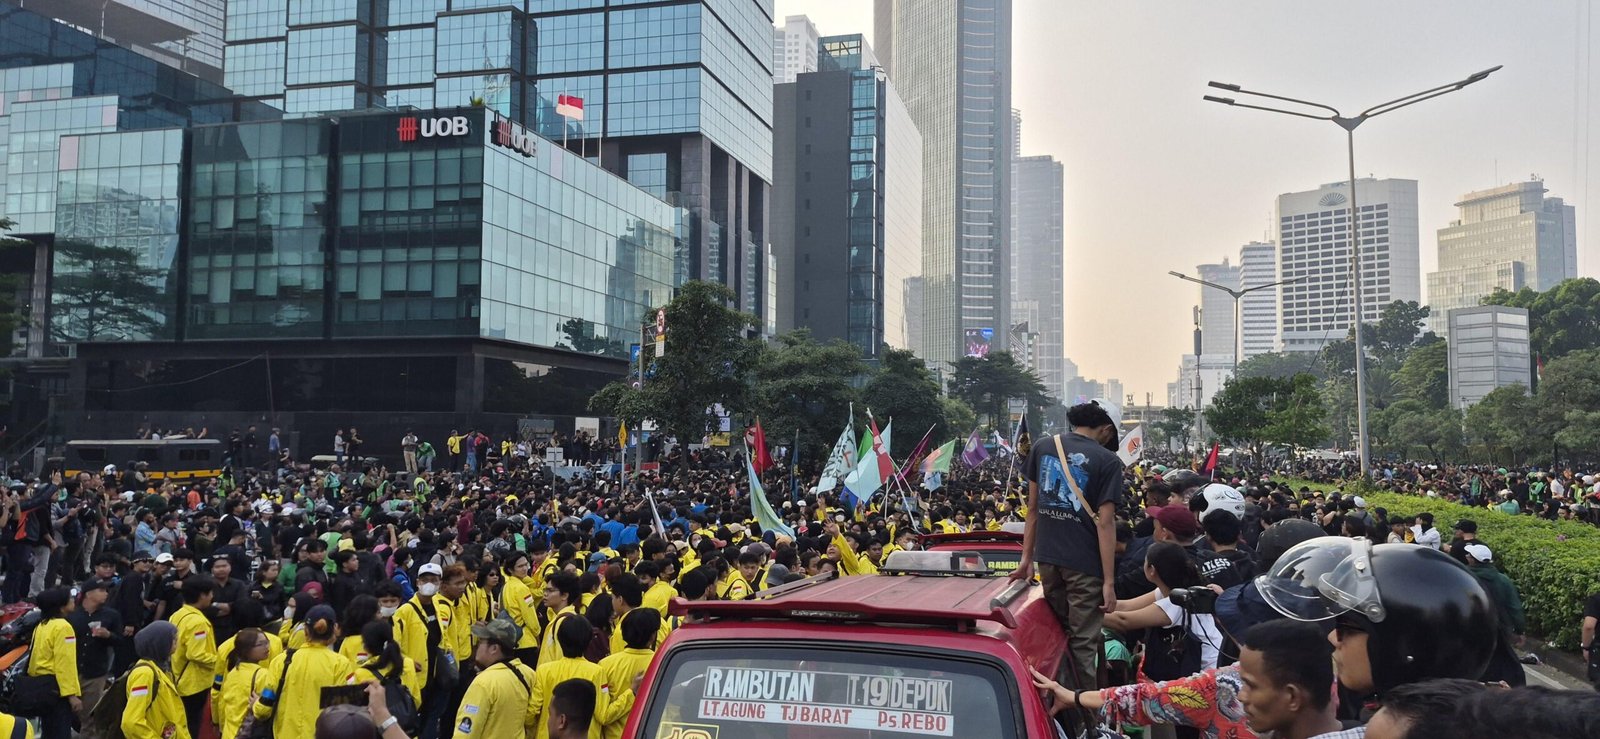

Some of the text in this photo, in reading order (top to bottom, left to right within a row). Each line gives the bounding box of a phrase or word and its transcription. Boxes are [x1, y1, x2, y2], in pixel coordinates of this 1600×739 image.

[421, 116, 469, 137] UOB
[511, 130, 538, 157] UOB
[707, 668, 950, 712] RAMBUTAN T.19 DEPOK
[703, 701, 947, 732] LT.AGUNG TJ.BARAT Ps.REBO
